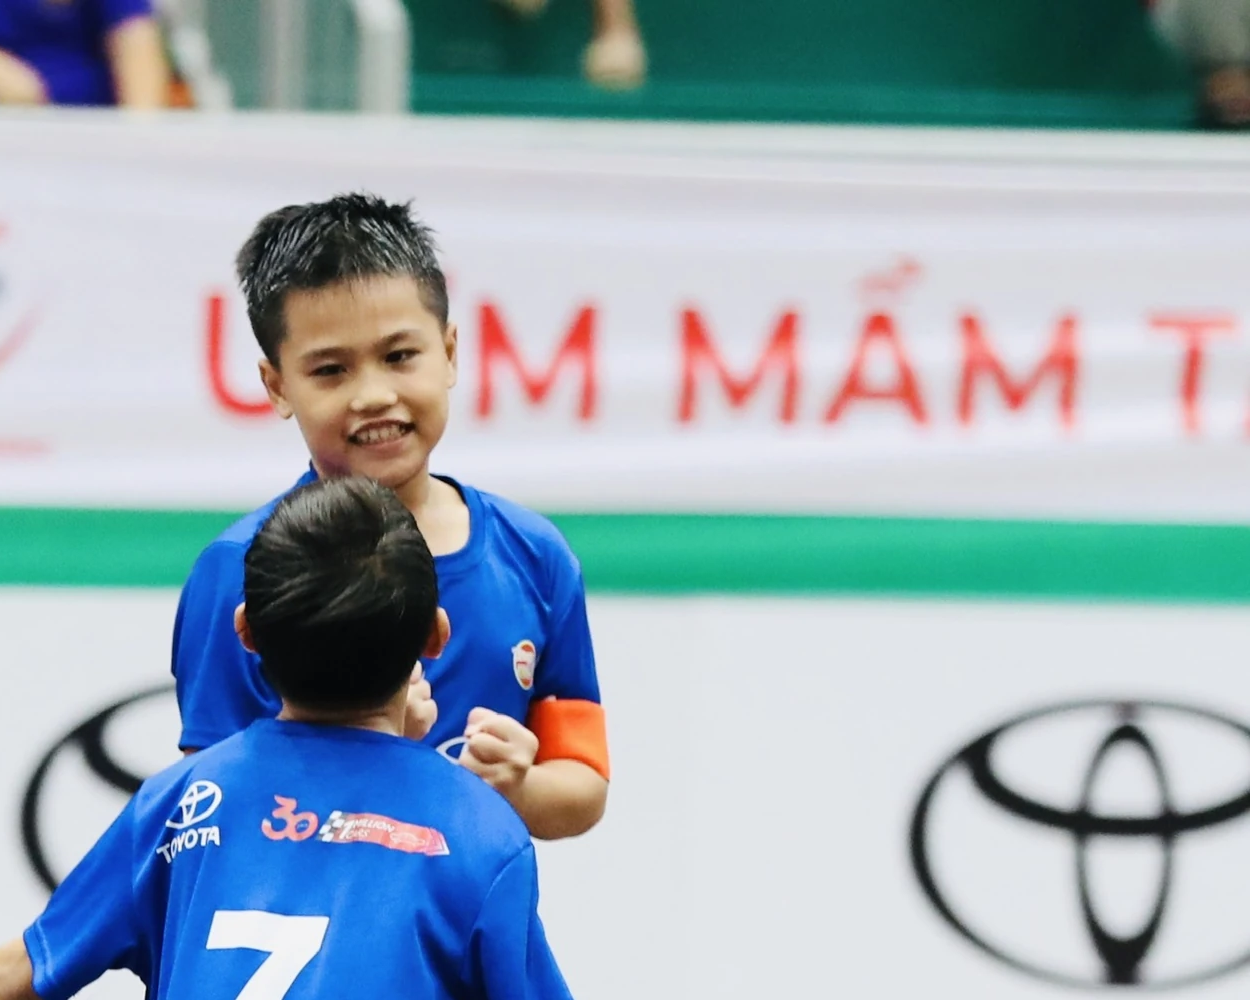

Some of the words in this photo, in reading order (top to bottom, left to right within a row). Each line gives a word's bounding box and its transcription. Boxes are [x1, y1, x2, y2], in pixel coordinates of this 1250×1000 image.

[1147, 313, 1250, 430] T
[261, 794, 318, 841] 30
[156, 826, 220, 864] TOYOTA
